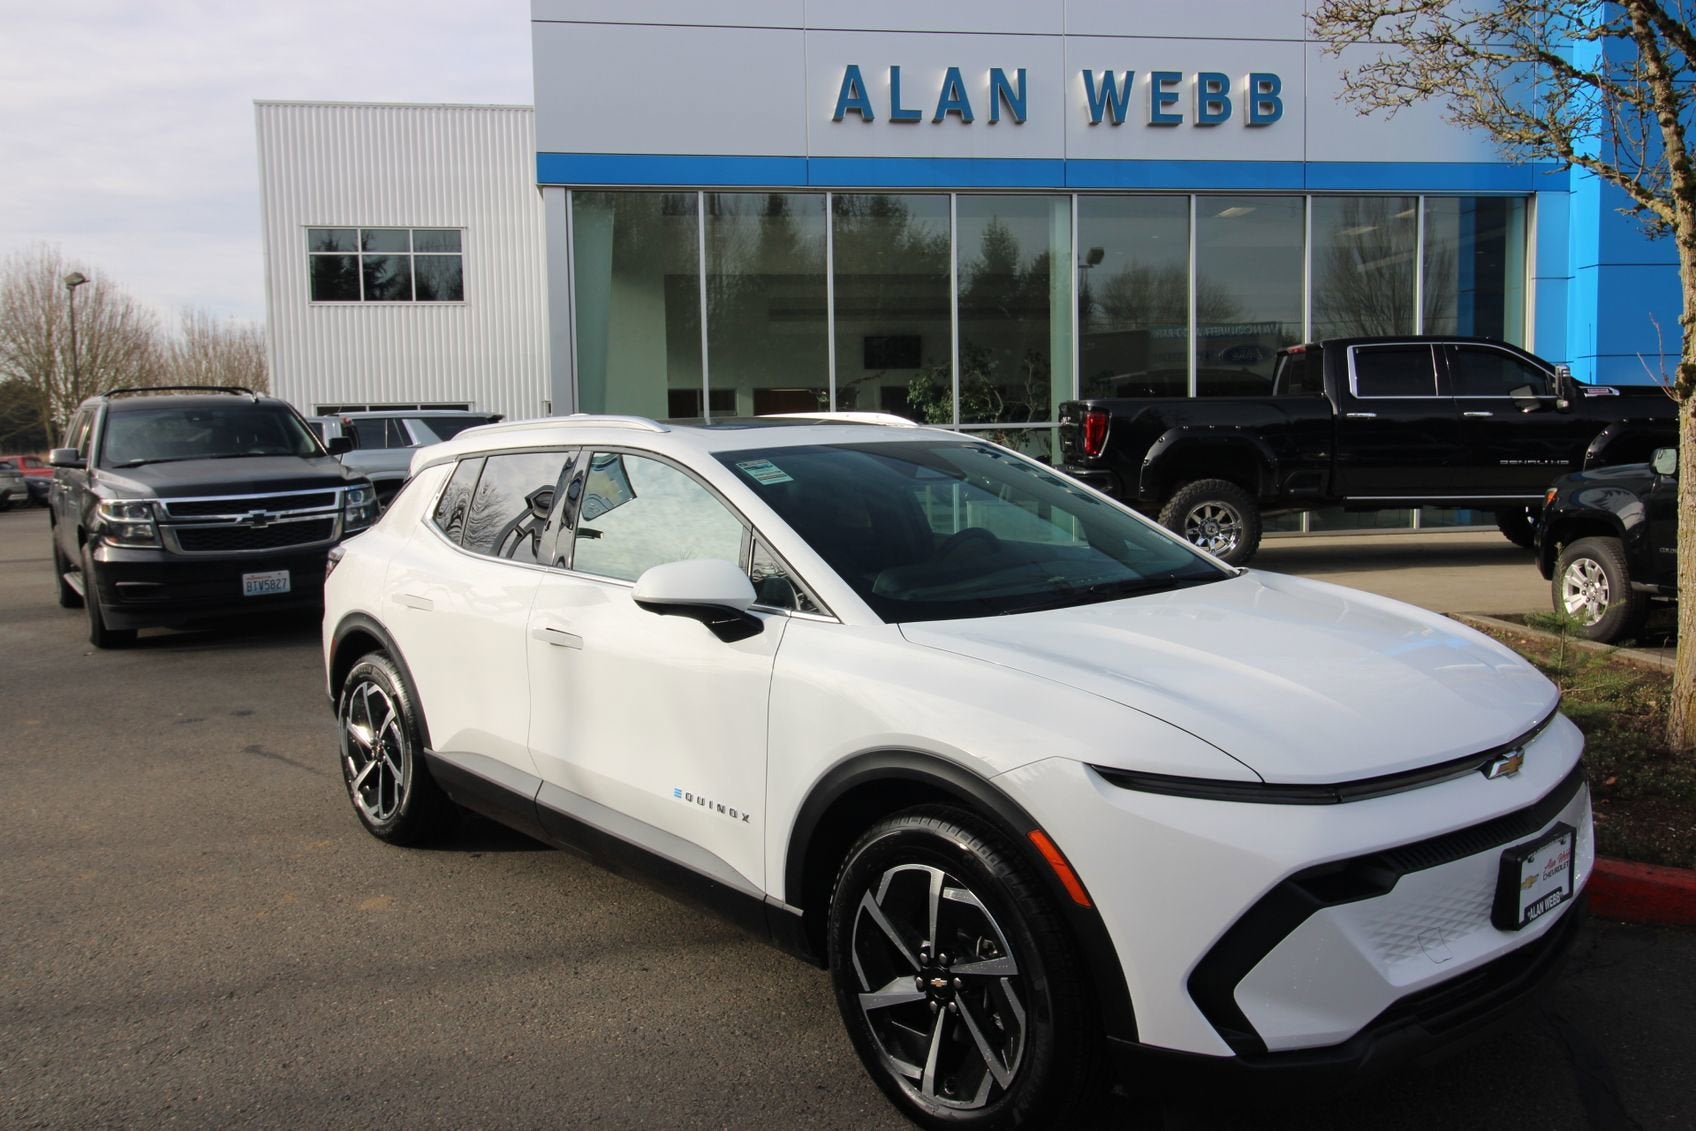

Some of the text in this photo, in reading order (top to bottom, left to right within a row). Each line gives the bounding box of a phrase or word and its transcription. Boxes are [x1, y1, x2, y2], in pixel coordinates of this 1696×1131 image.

[832, 65, 1284, 127] ALAN WEBB
[246, 577, 287, 593] BTV5827
[673, 787, 750, 823] EQUINOX
[1542, 861, 1569, 881] CHEVROLET
[1529, 892, 1561, 921] ALAN WEBB
